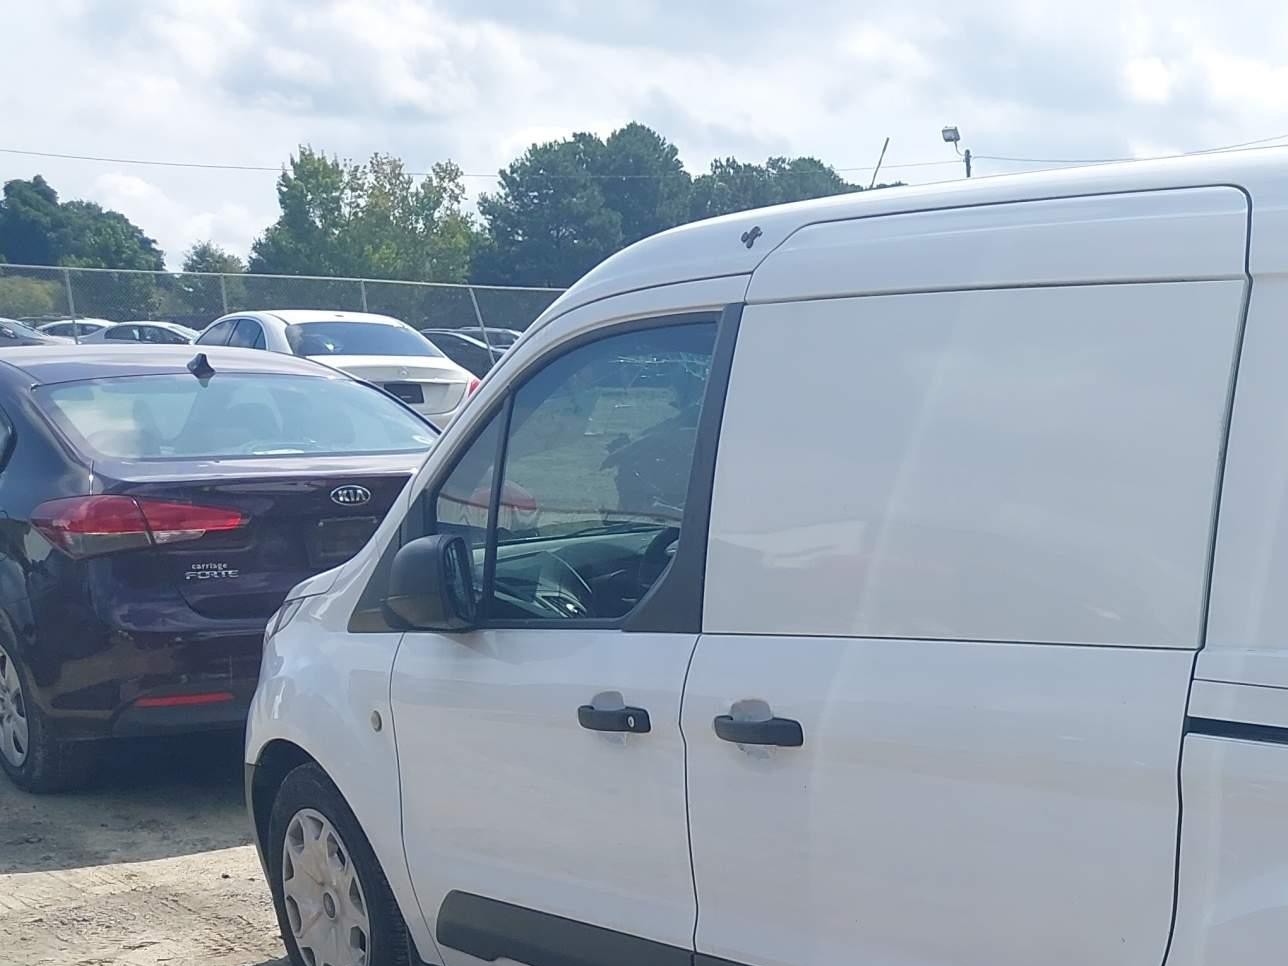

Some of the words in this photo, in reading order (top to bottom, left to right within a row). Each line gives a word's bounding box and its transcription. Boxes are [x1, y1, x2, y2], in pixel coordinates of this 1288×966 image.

[337, 488, 367, 503] KIA
[191, 562, 228, 571] carriage
[184, 569, 240, 580] FORTE
